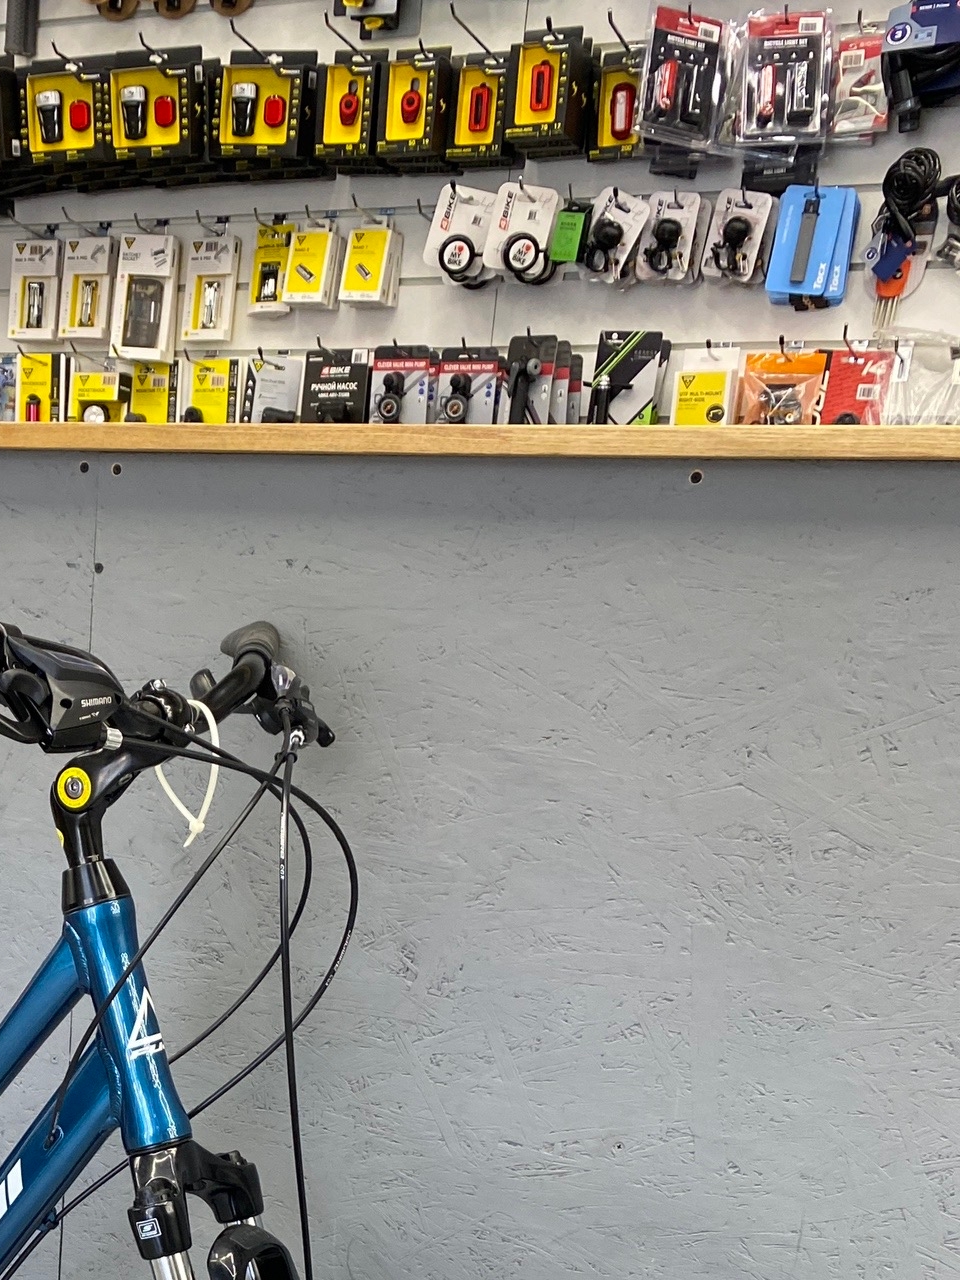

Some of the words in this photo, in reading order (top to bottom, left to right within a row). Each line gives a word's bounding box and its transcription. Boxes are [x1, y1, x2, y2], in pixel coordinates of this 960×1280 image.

[449, 251, 462, 259] MY
[516, 248, 527, 257] MY
[512, 255, 526, 266] BIKE
[813, 262, 828, 290] Tacx
[829, 264, 841, 292] Tacx
[321, 365, 351, 374] 4BIKE
[311, 381, 337, 391] РУЧНОЙ
[337, 381, 358, 390] НАСОС
[81, 696, 112, 708] SHIMANO
